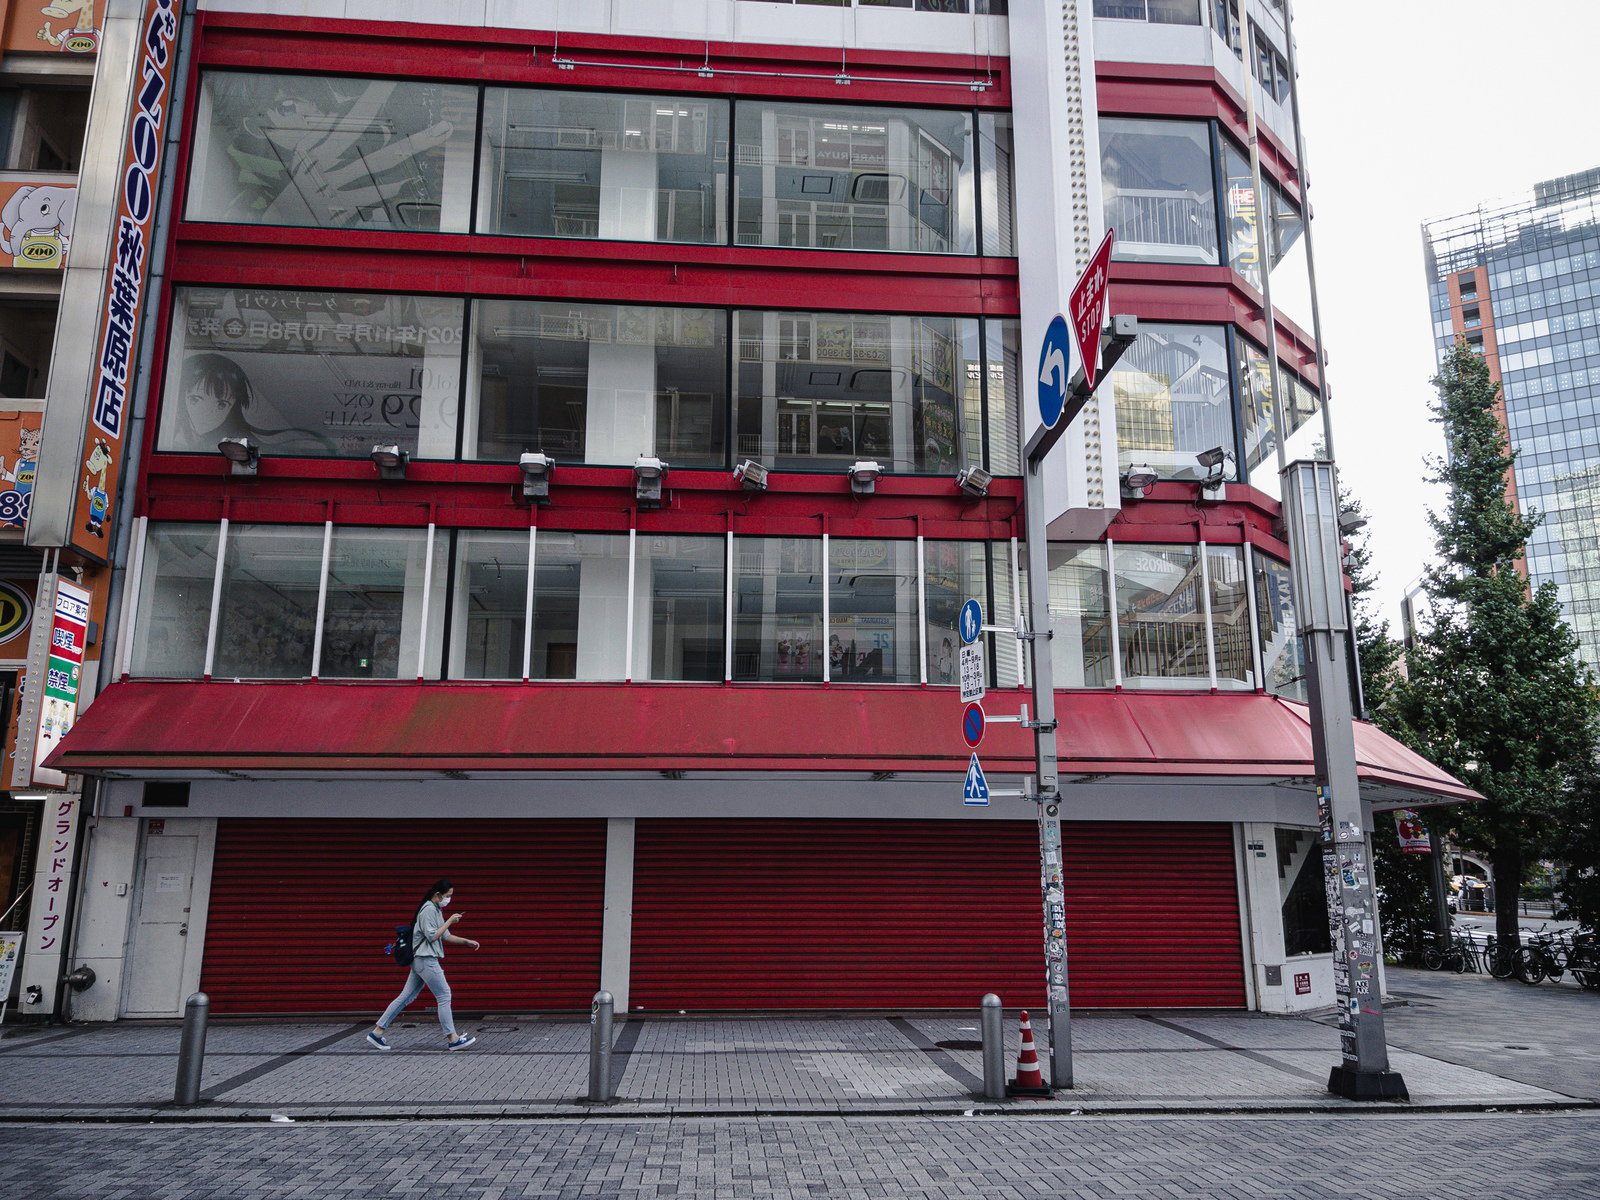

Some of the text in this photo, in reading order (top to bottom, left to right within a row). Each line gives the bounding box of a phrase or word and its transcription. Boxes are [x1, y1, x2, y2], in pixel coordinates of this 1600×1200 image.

[69, 41, 94, 49] ZOO
[27, 246, 54, 257] ZOO
[1077, 264, 1104, 322] 止まれ
[1081, 300, 1101, 343] STOP
[1193, 334, 1203, 346] 4
[56, 597, 87, 618] フロア案内
[40, 800, 75, 950] グランドオープン
